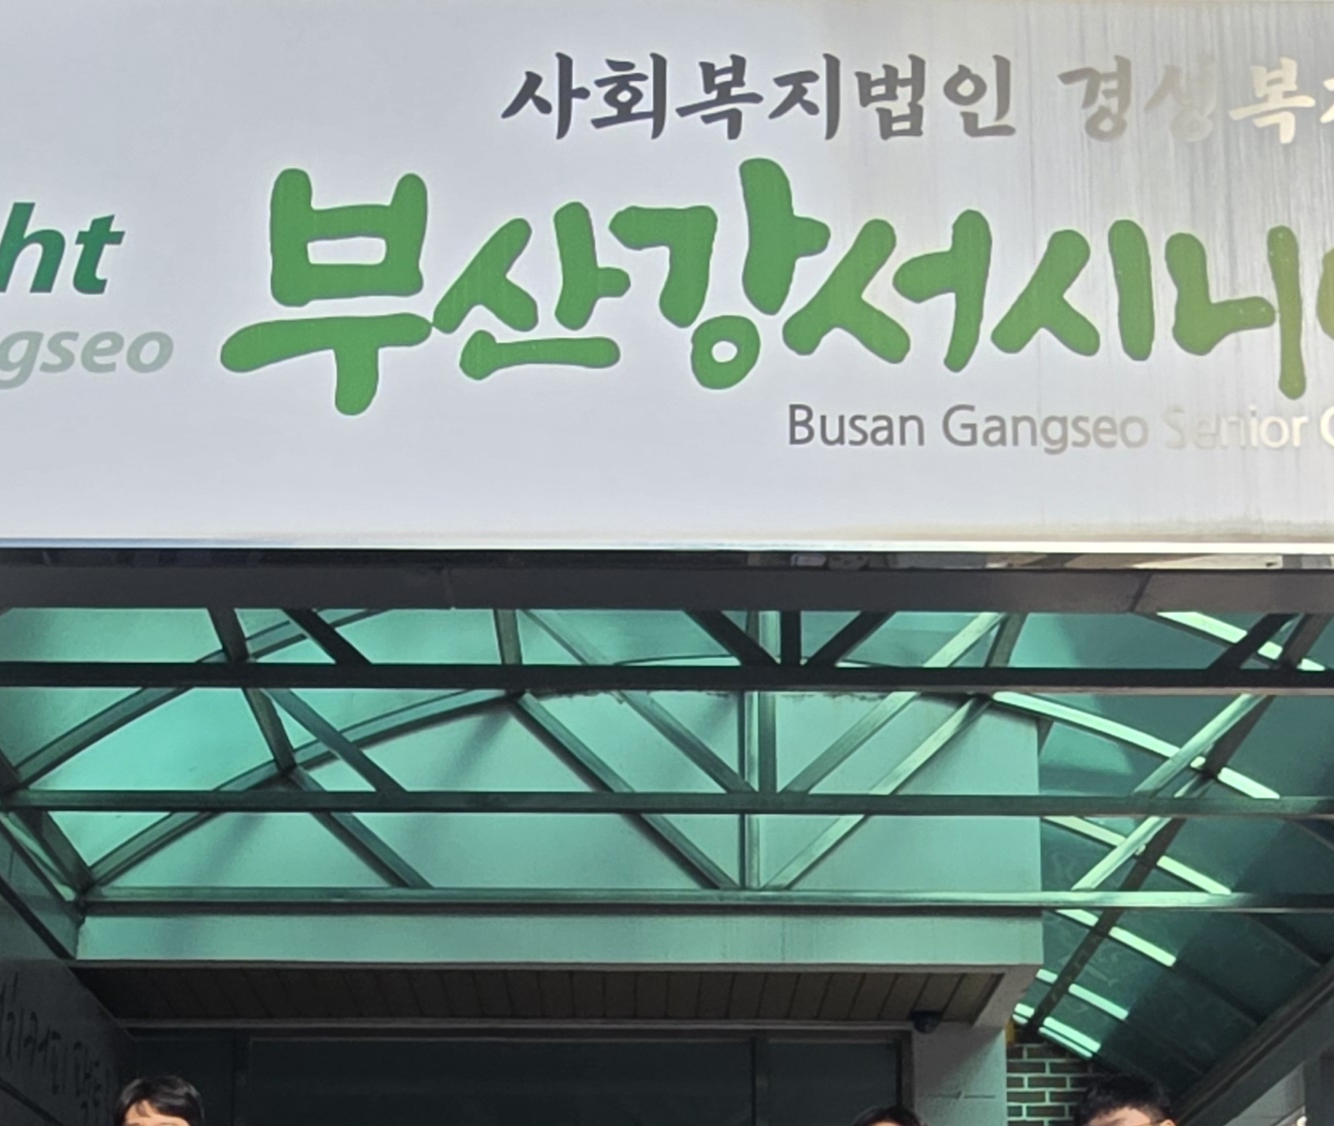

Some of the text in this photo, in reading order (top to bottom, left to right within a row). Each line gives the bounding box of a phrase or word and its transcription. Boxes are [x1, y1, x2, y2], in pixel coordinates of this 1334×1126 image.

[502, 53, 1016, 141] 사회복지법인
[788, 403, 925, 447] Busan
[942, 403, 1148, 455] Gangseo
[1164, 404, 1309, 450] Senior
